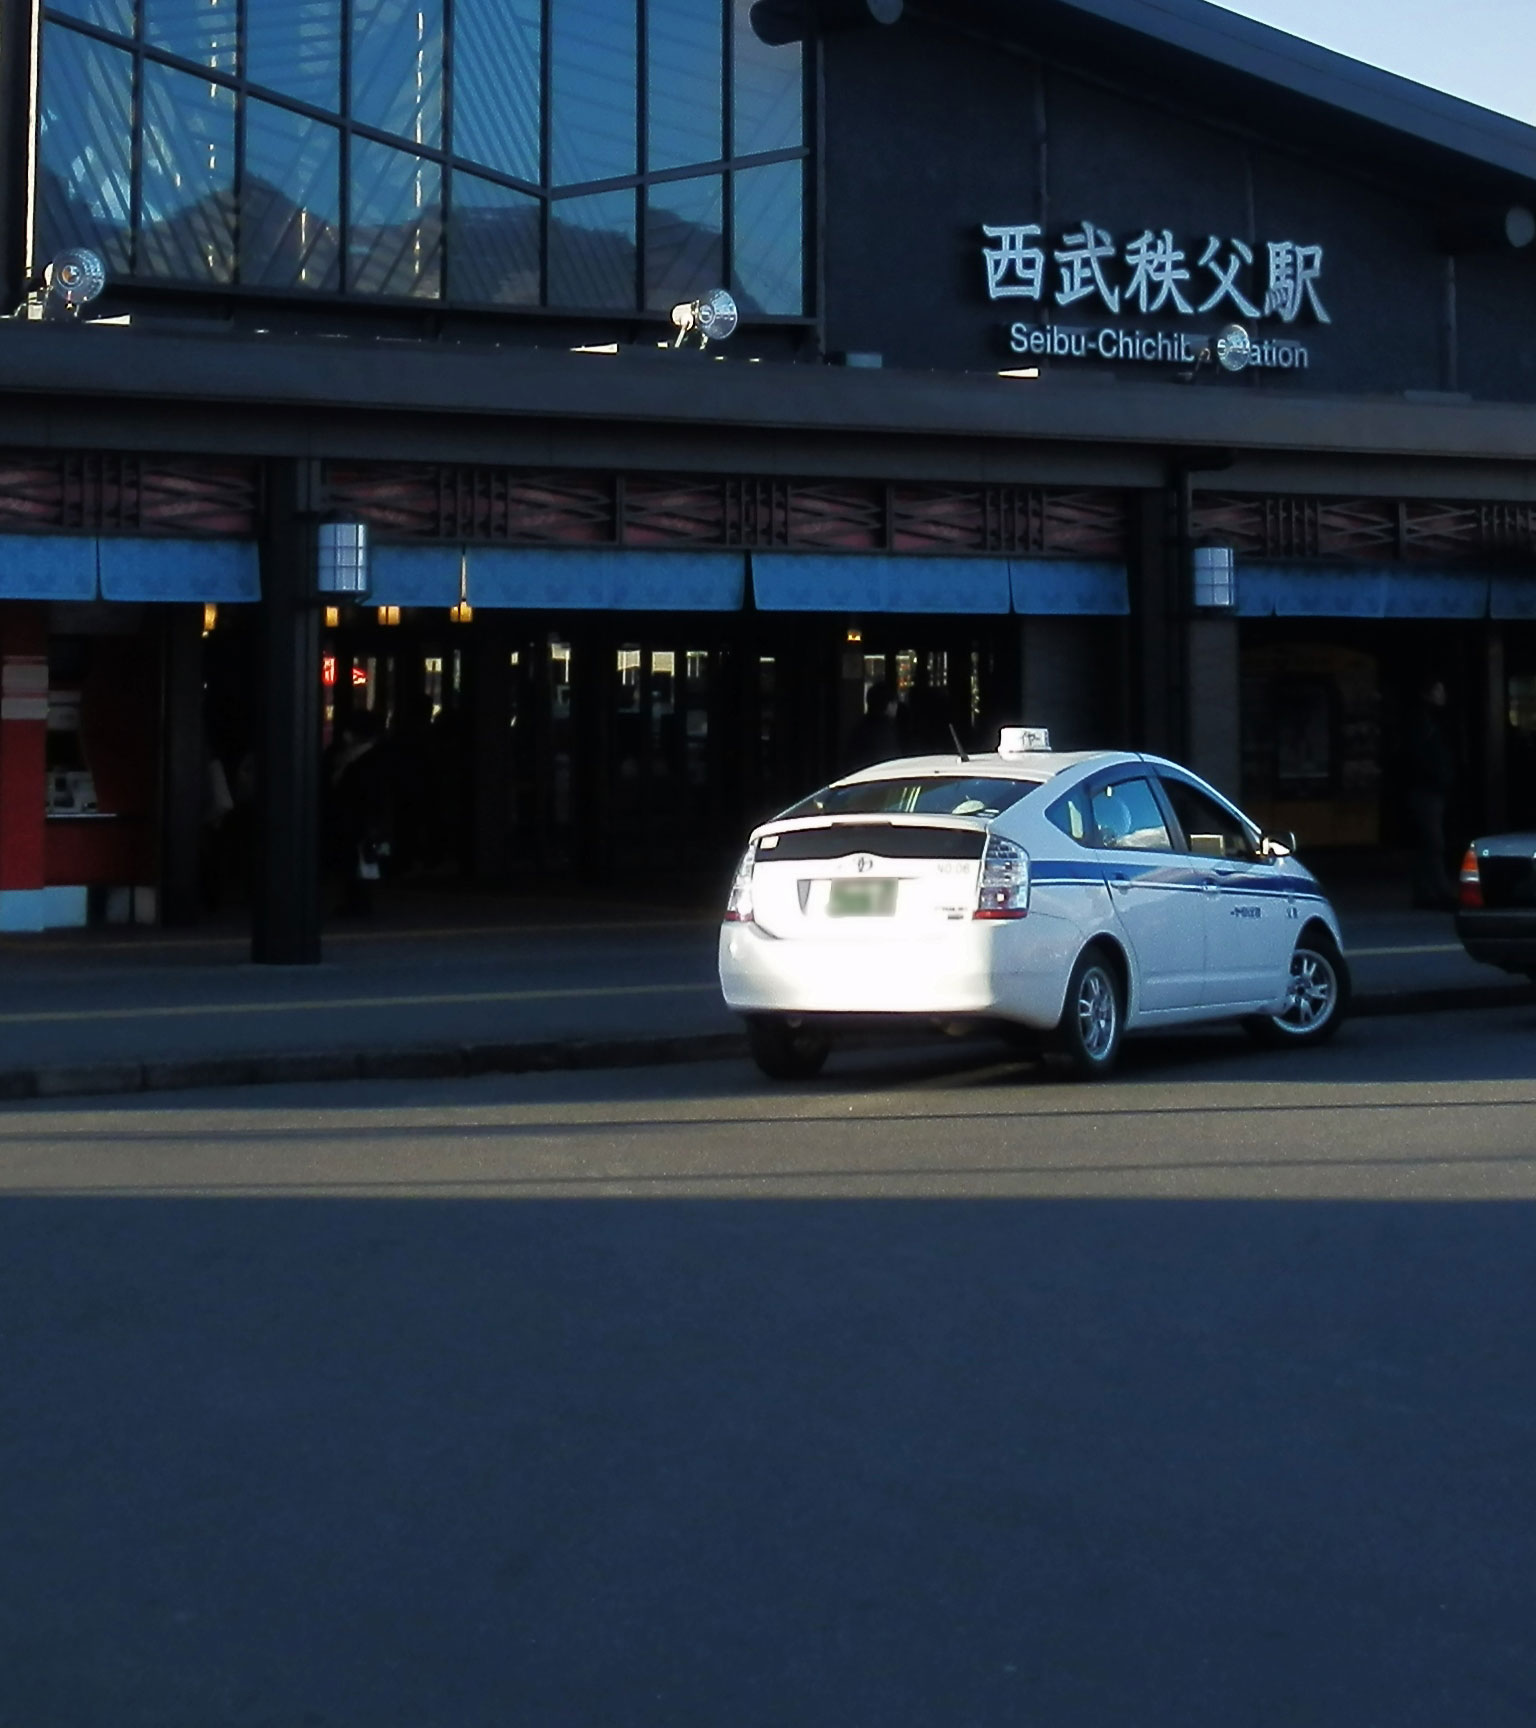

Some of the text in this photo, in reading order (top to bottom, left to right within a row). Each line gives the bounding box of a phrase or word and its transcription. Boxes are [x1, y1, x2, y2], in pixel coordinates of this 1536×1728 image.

[982, 221, 1332, 324] 西武秩父駅
